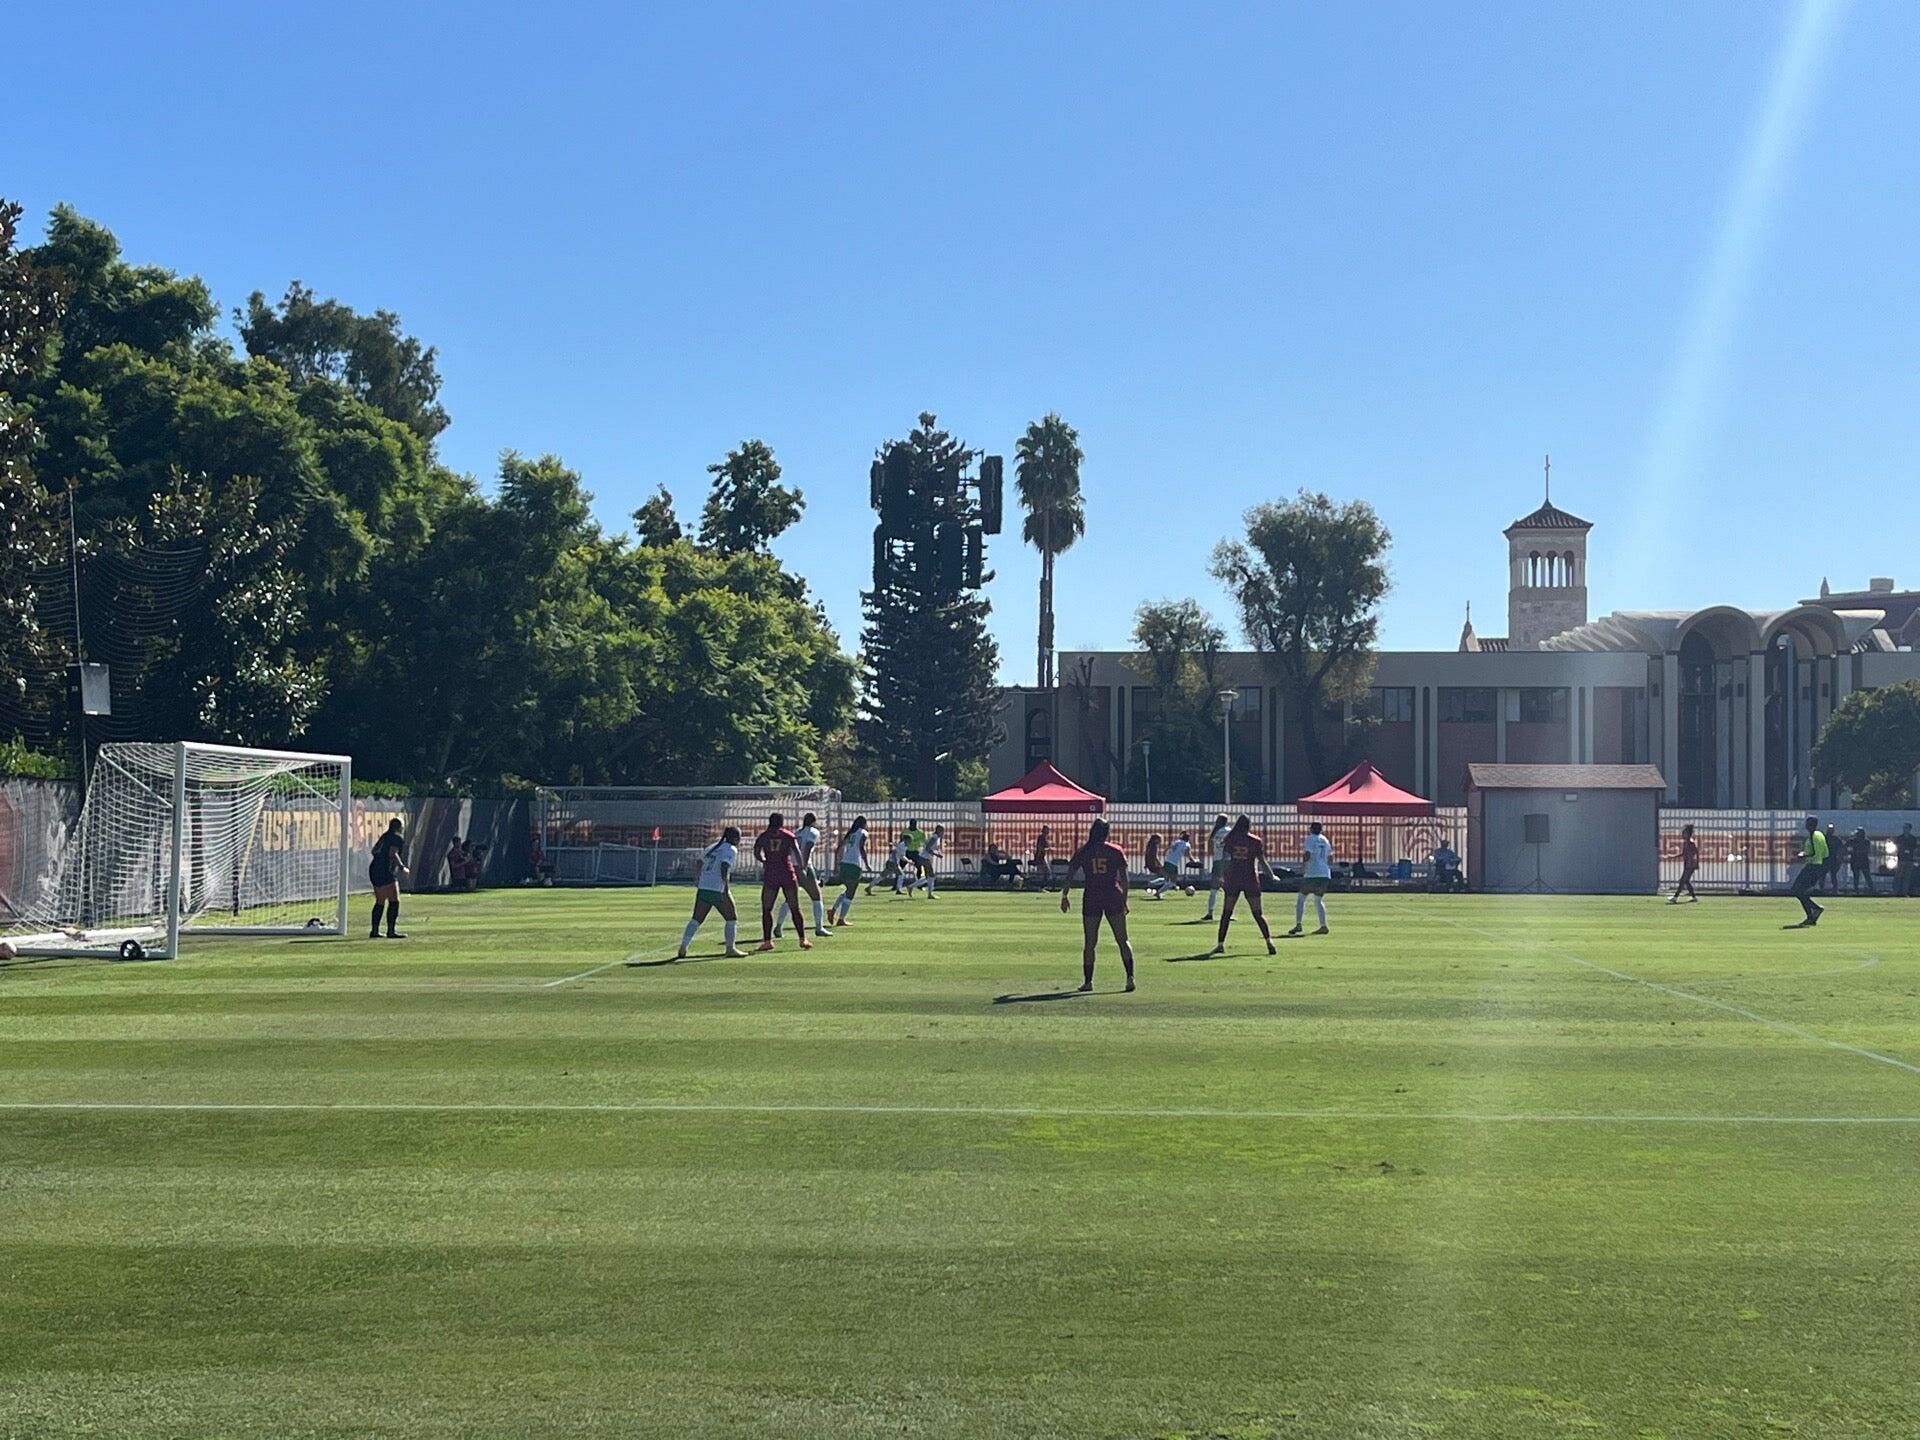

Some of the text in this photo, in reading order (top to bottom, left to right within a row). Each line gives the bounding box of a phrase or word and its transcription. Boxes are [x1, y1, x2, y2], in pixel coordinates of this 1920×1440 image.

[262, 811, 291, 850] USC
[364, 811, 396, 848] FIGH
[769, 838, 783, 852] 17
[1092, 858, 1108, 874] 15
